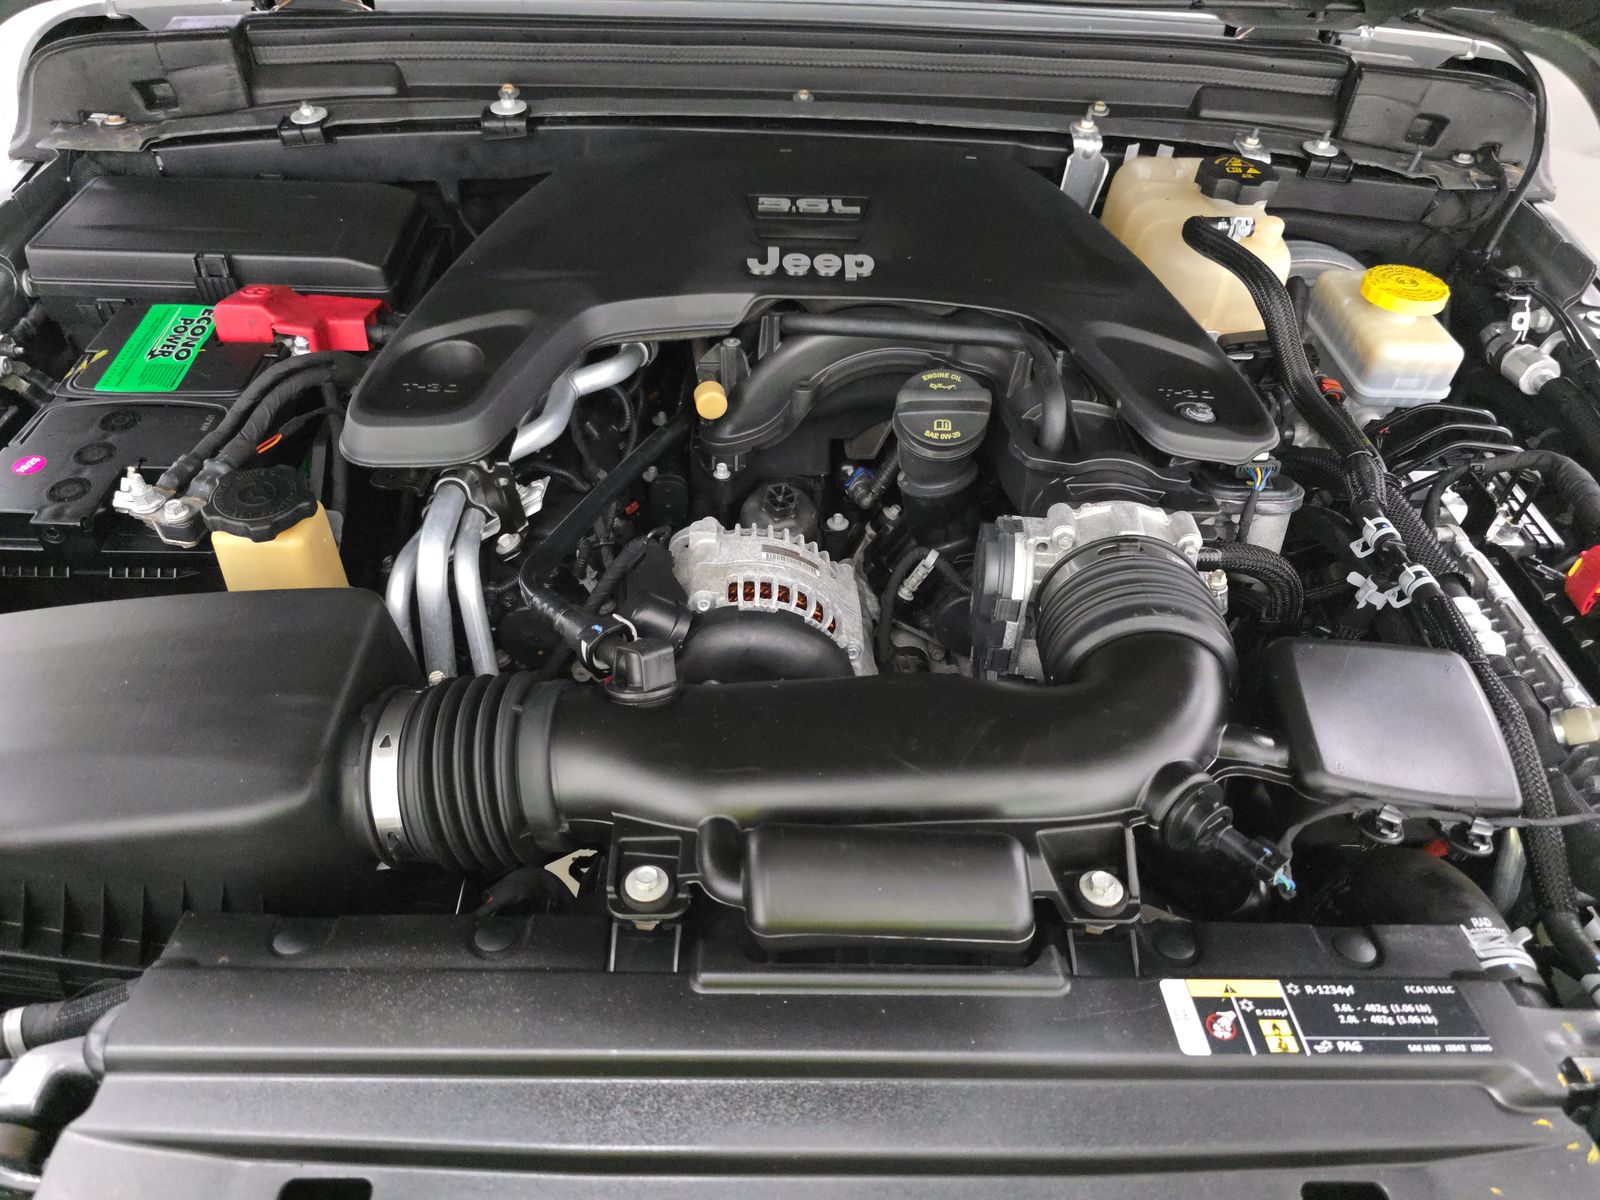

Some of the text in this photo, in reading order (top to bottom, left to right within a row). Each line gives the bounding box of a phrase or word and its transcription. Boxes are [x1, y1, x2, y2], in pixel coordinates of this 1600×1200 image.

[757, 197, 861, 214] 3.6L
[746, 246, 875, 281] Jeep
[154, 317, 197, 359] POWER
[174, 308, 214, 361] ECONO
[922, 372, 962, 382] ENGINE OIL
[924, 430, 961, 440] SAE 0W-20
[1470, 917, 1493, 928] RAD
[1305, 985, 1355, 997] R-1234yf
[1404, 985, 1456, 994] FCA US LLC
[1337, 1041, 1363, 1052] PAG
